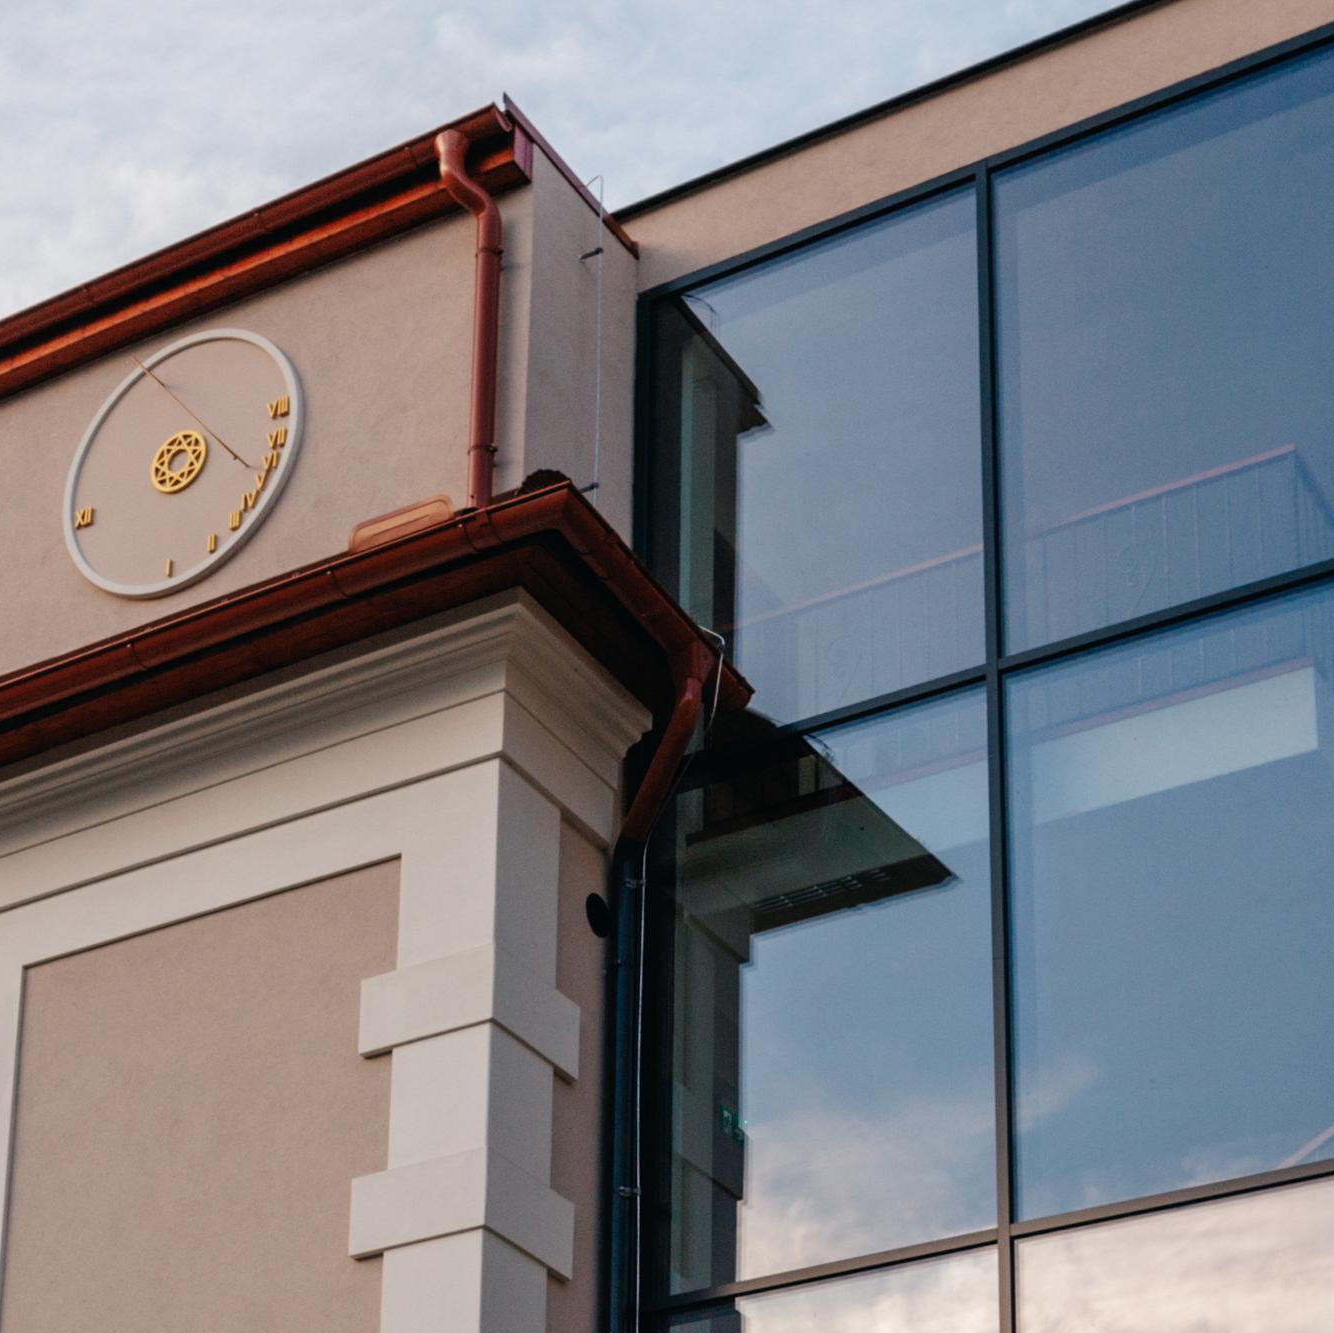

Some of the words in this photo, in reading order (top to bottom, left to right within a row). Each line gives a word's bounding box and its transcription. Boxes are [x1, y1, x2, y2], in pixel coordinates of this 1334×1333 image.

[267, 394, 290, 420] VIII
[267, 426, 287, 451] VII
[261, 450, 279, 475] VI
[255, 468, 268, 491] V
[239, 489, 259, 514] IV
[74, 505, 95, 530] XII
[228, 510, 242, 531] III
[206, 532, 217, 554] II
[165, 558, 173, 578] I
